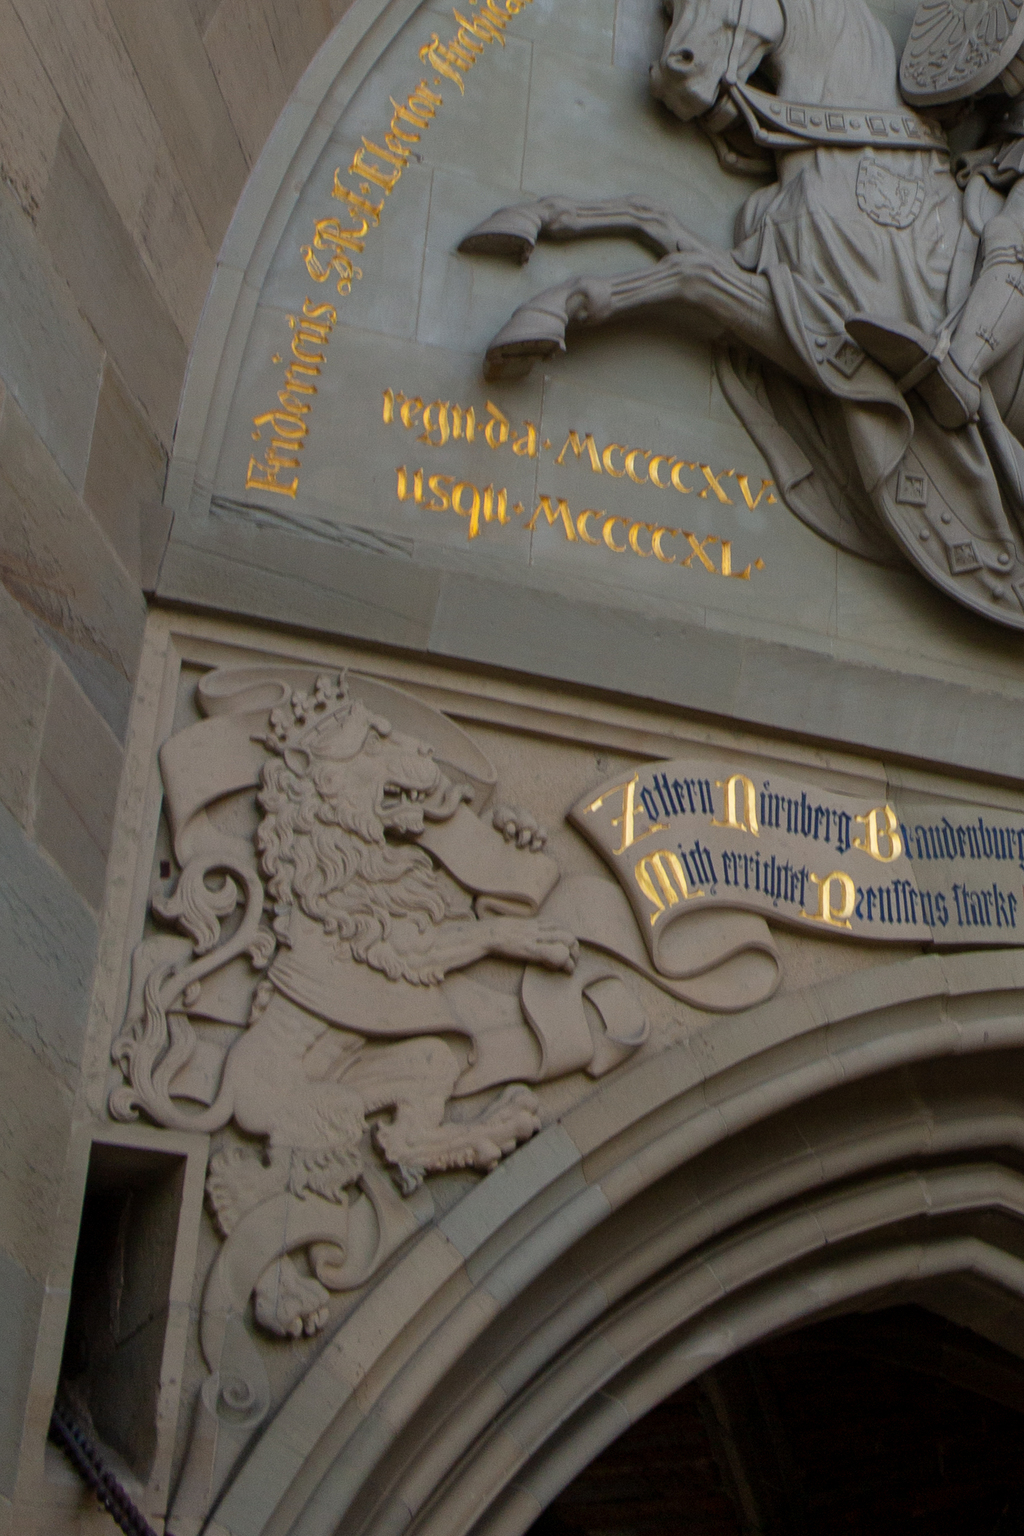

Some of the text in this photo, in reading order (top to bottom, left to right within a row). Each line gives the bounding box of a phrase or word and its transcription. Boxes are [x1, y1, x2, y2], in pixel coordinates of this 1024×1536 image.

[583, 771, 715, 856] Zollern
[634, 839, 719, 926] Mich
[721, 850, 810, 907] errichtet
